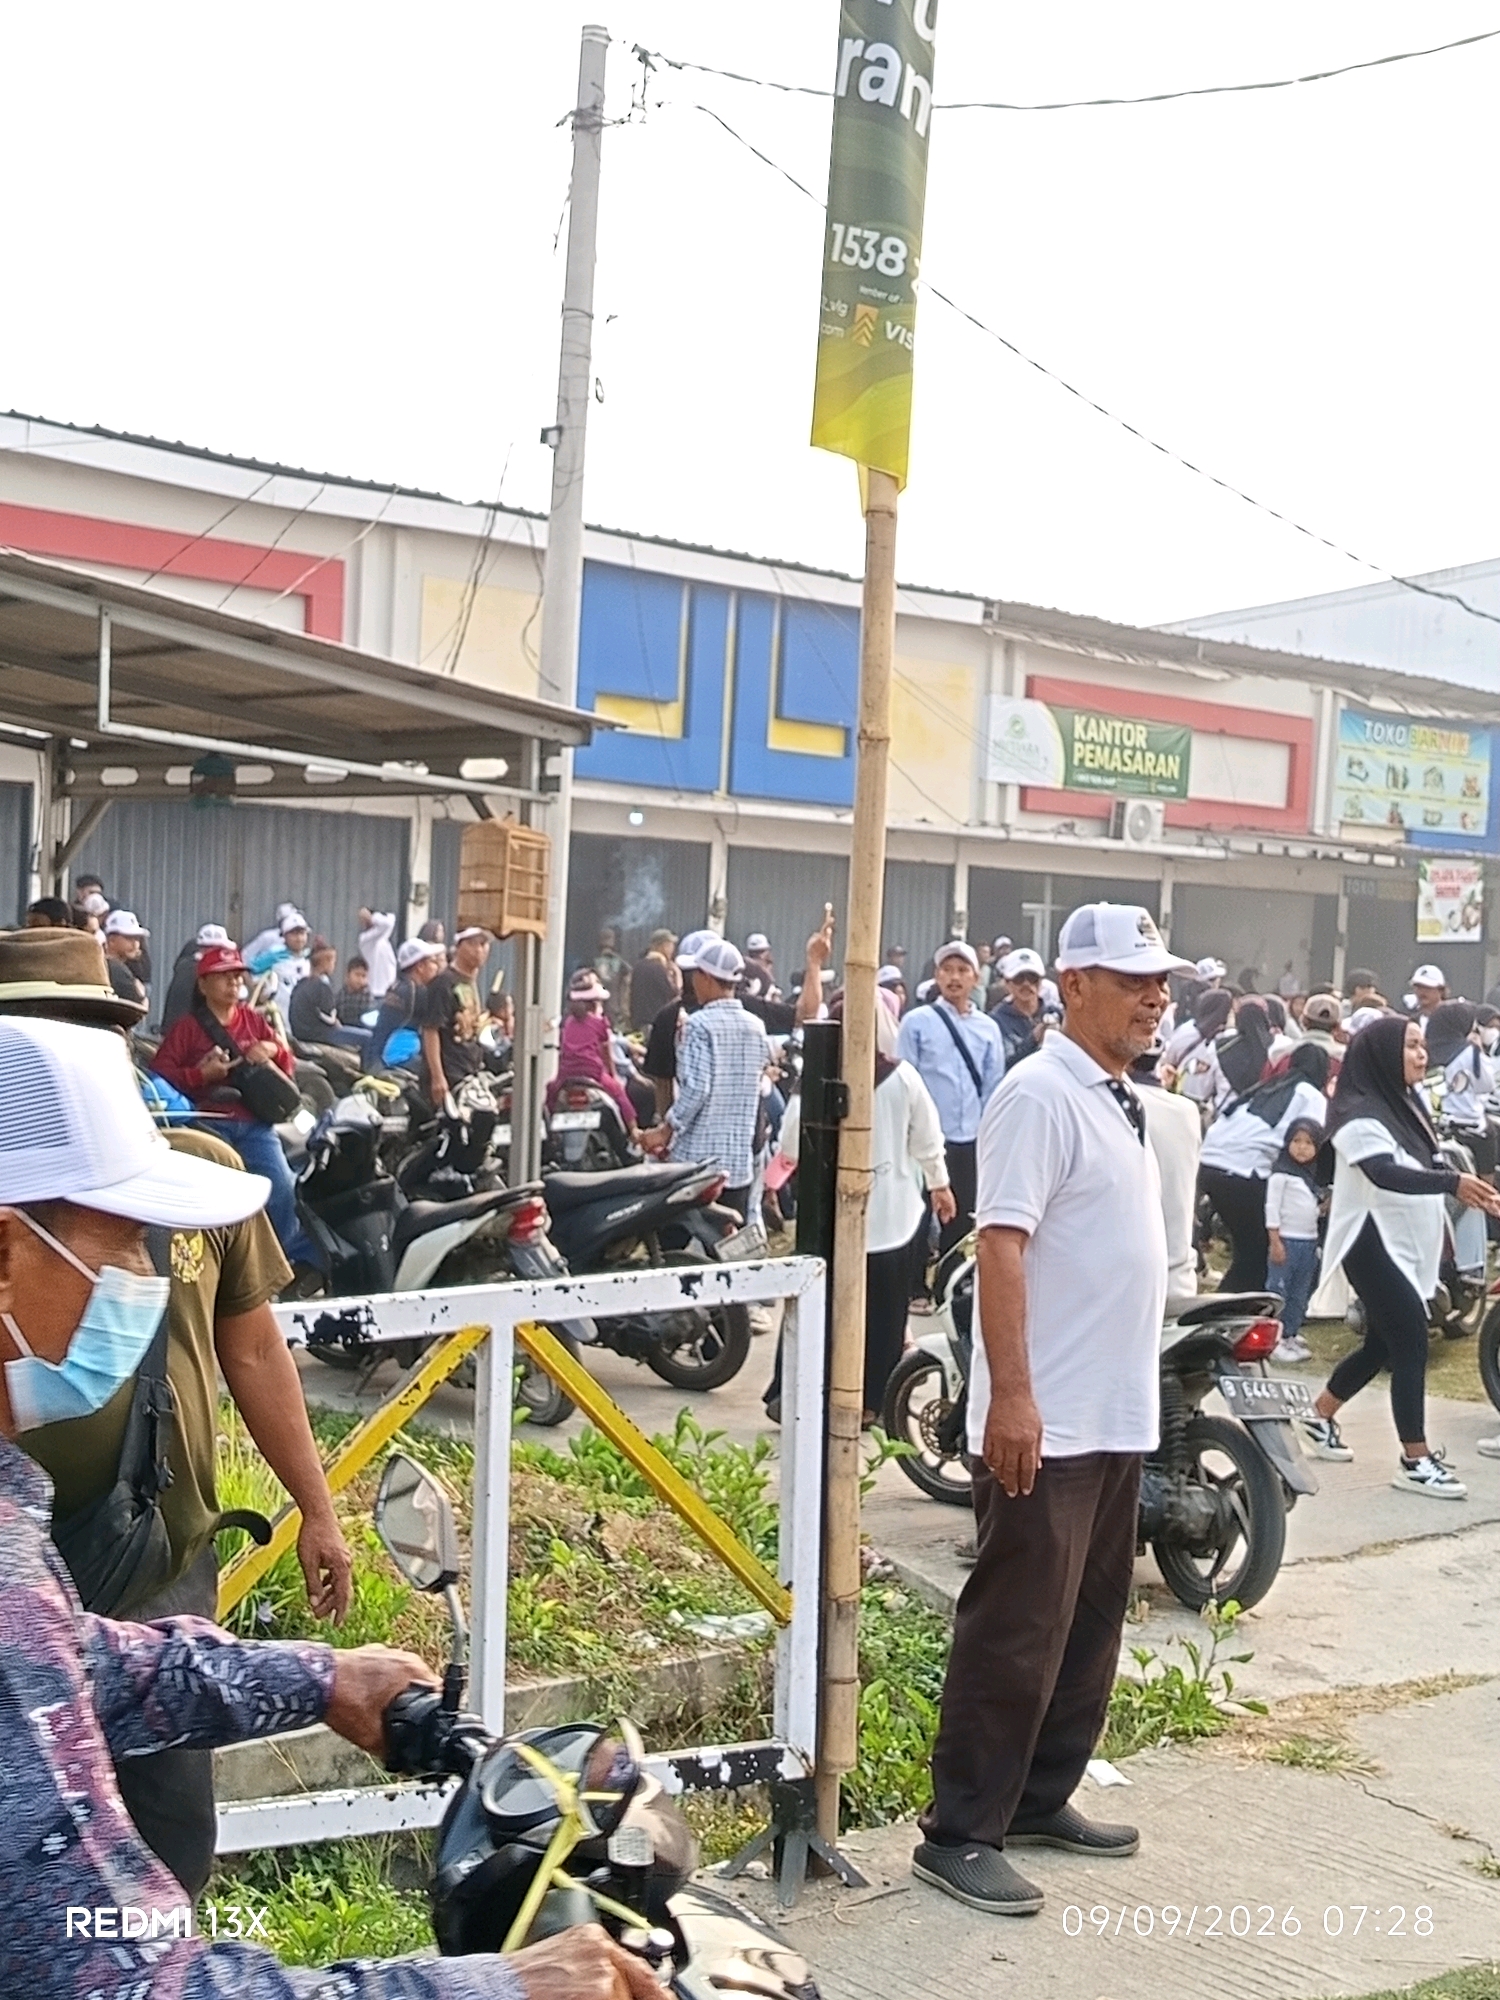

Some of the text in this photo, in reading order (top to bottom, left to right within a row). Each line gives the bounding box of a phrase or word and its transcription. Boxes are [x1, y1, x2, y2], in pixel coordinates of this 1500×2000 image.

[831, 223, 908, 277] 1538
[1074, 714, 1147, 750] KANTOR
[1364, 720, 1407, 747] TOKO
[1073, 741, 1180, 779] PEMASARAN
